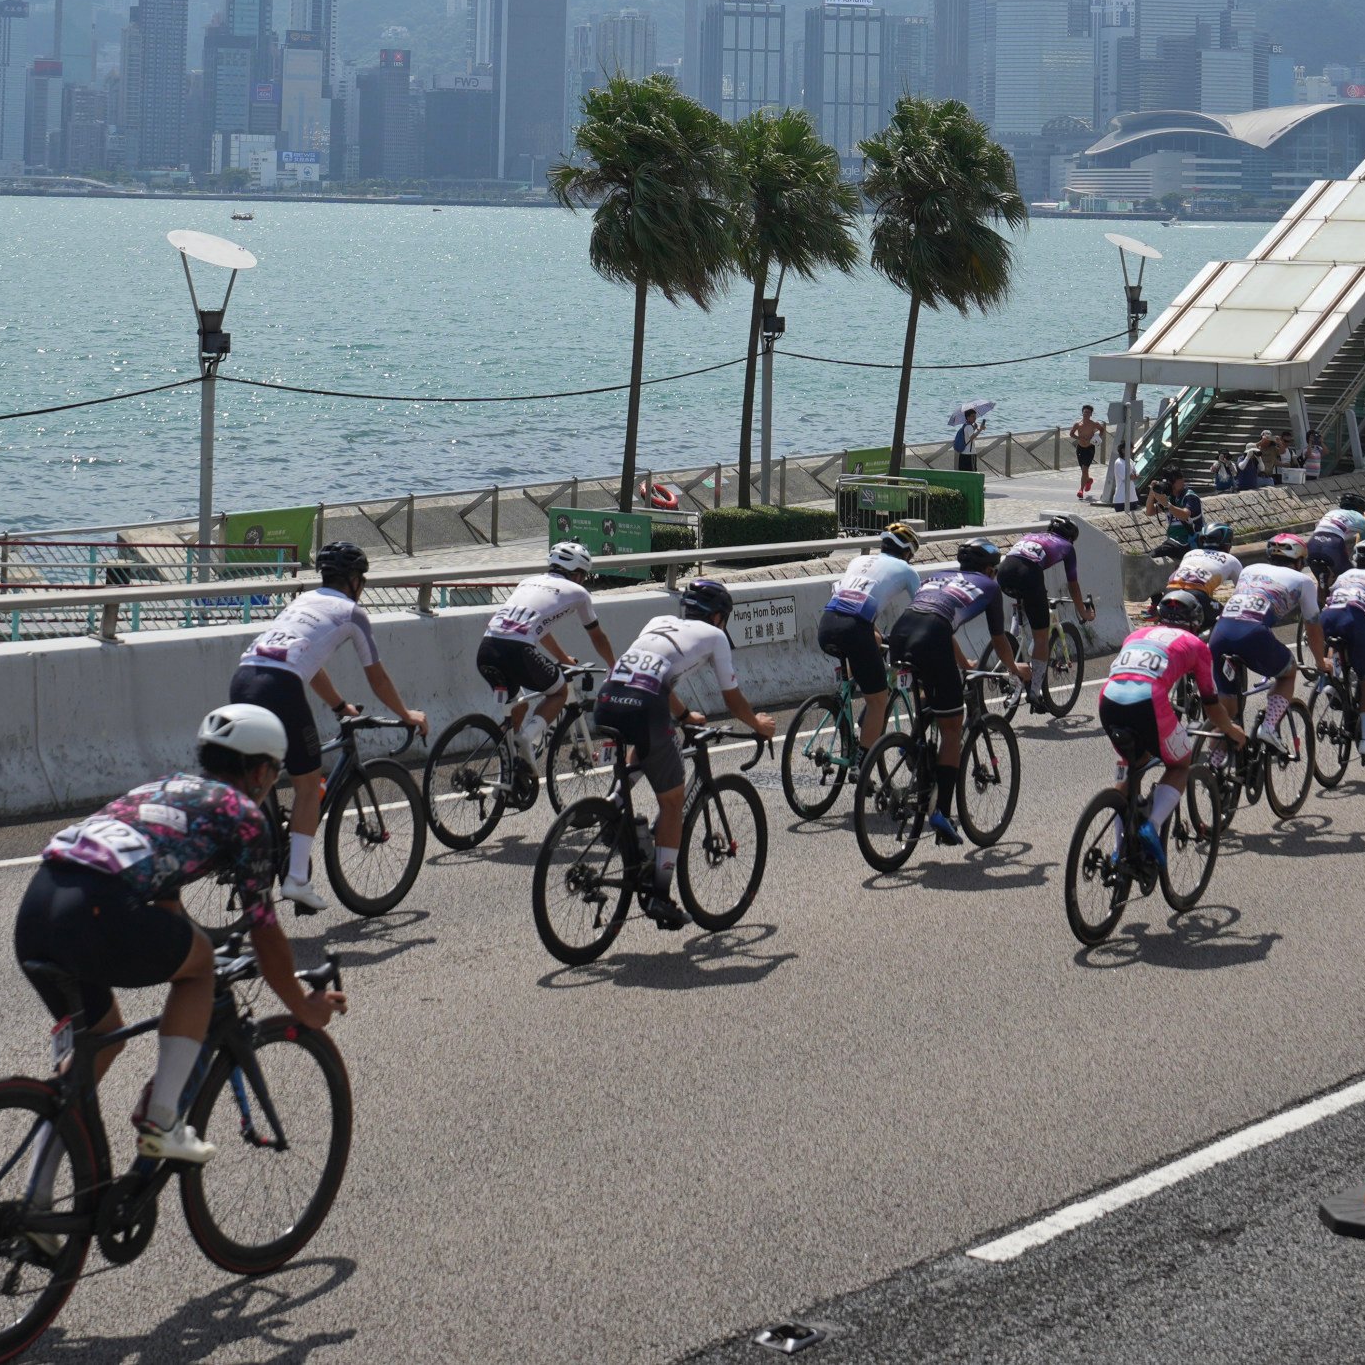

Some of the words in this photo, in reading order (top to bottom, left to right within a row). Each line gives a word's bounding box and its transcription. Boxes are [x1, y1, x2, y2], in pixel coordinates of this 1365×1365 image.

[455, 77, 479, 87] FWD
[840, 165, 861, 178] agle
[1245, 596, 1266, 611] 39
[542, 608, 570, 627] RUDY
[734, 610, 752, 622] Hung
[753, 607, 769, 618] Hom
[770, 604, 794, 617] Bypass
[615, 654, 639, 675] 84
[639, 654, 664, 675] 84
[1138, 652, 1161, 671] 20
[609, 695, 642, 706] SUCCESS
[92, 823, 147, 853] 127
